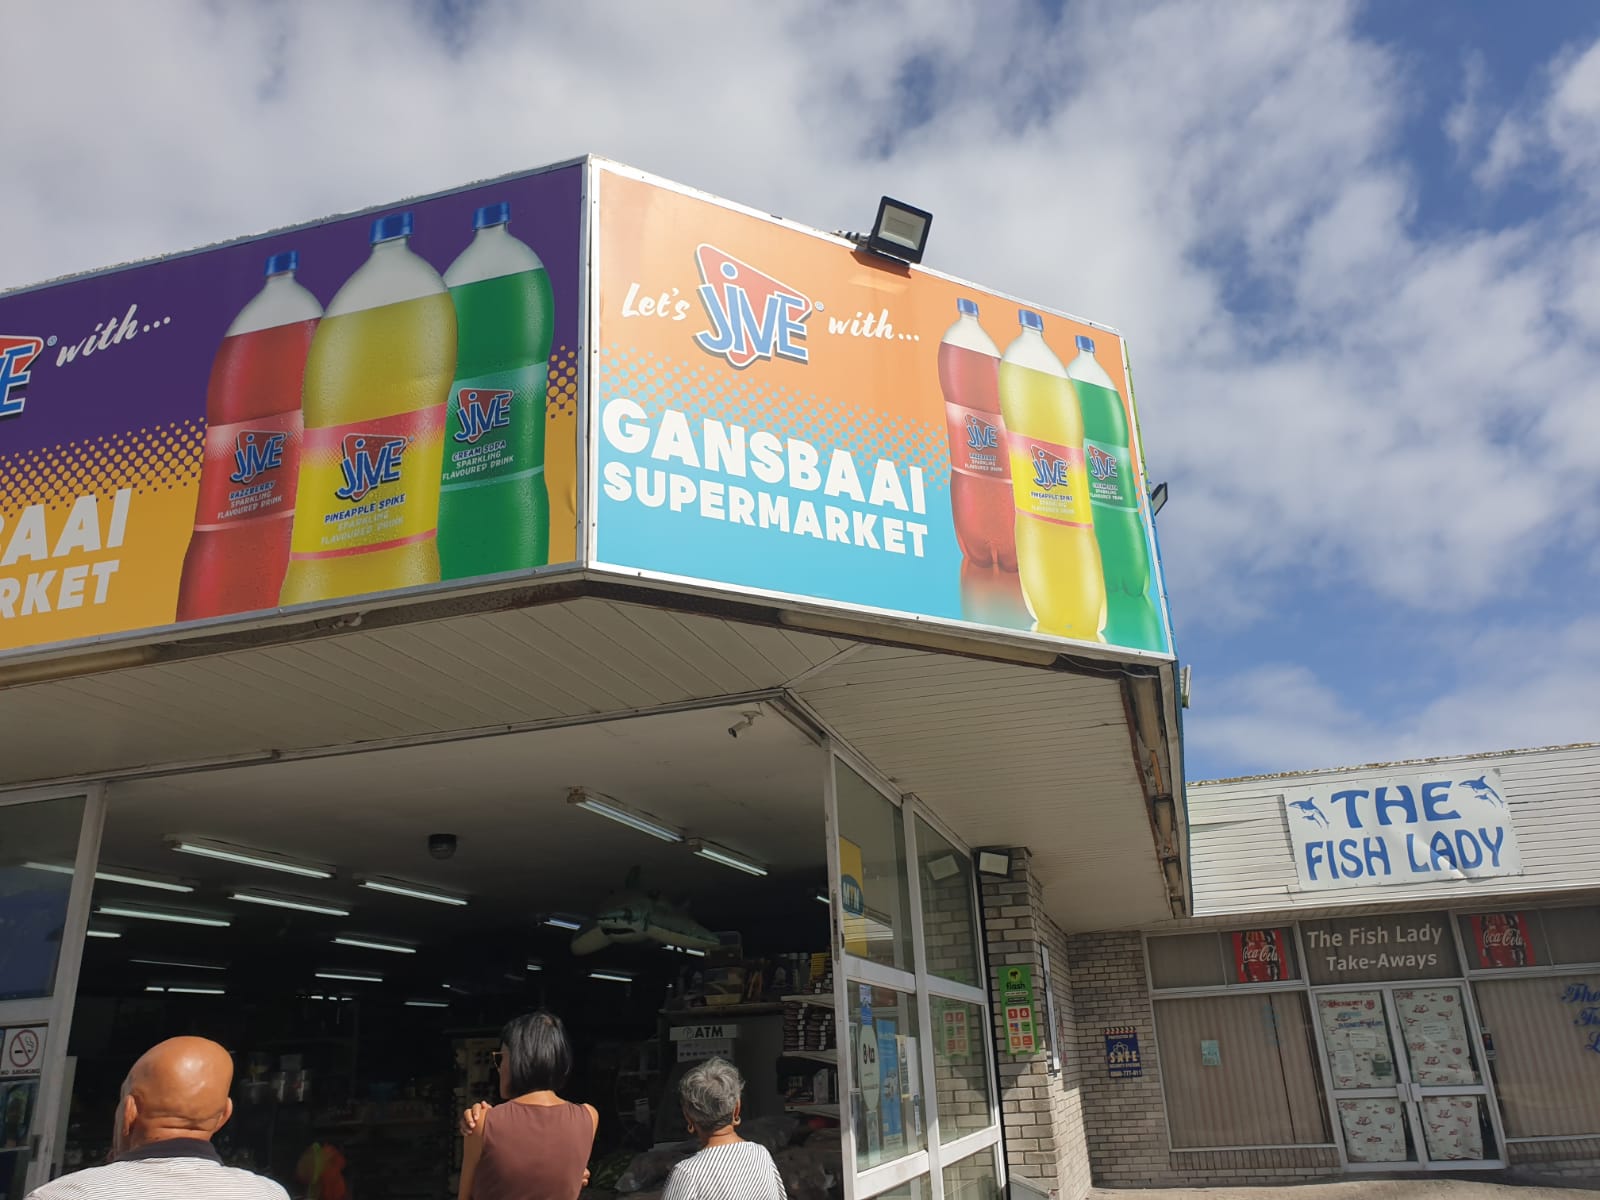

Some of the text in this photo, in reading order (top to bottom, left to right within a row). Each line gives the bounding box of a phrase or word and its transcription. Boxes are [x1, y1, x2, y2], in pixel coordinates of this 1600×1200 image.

[621, 282, 690, 321] Let's
[601, 397, 927, 515] GANSBAAI
[0, 487, 133, 567] AAI
[324, 493, 406, 524] PINEAPPLE SPIKE
[602, 461, 929, 558] SUPERMARKET
[1330, 780, 1462, 829] THE
[1305, 826, 1504, 881] FISH LADY
[1307, 923, 1442, 949] The Fish Lady
[1326, 953, 1438, 972] Take-Aways
[694, 1025, 724, 1039] ATM
